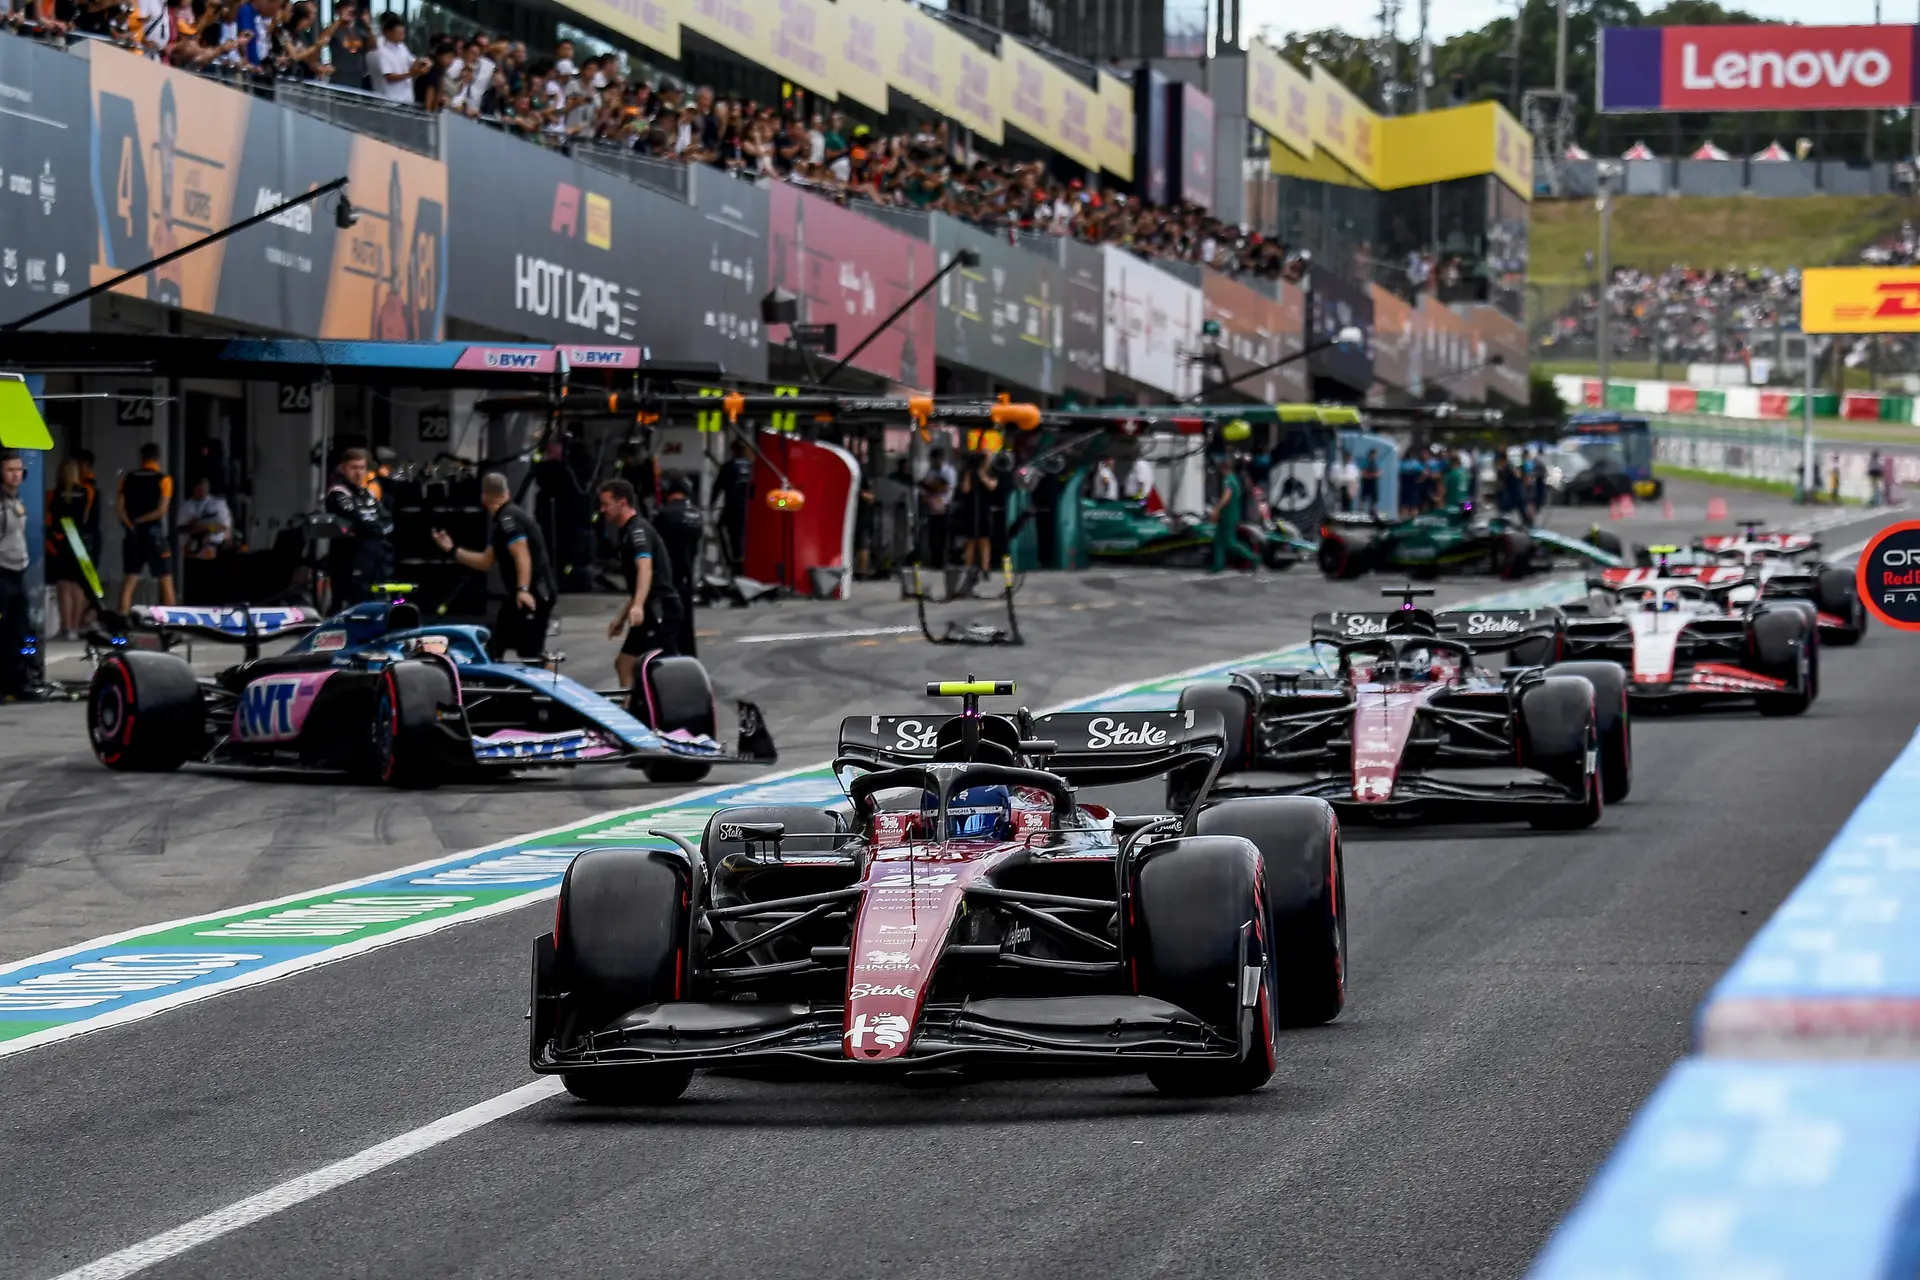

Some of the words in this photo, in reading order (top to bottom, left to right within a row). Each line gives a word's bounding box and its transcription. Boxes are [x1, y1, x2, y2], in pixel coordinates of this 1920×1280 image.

[1682, 42, 1891, 90] Lenovo
[515, 253, 564, 320] HOT
[499, 352, 539, 367] BWT
[586, 350, 623, 364] BWT
[120, 396, 153, 421] 24
[281, 385, 311, 409] 26
[421, 415, 450, 438] 28
[1883, 570, 1913, 586] Red
[1467, 612, 1521, 635] Stake
[1086, 716, 1168, 750] Stake
[719, 823, 743, 840] Stake
[870, 873, 958, 888] 24
[849, 983, 916, 1001] Stake
